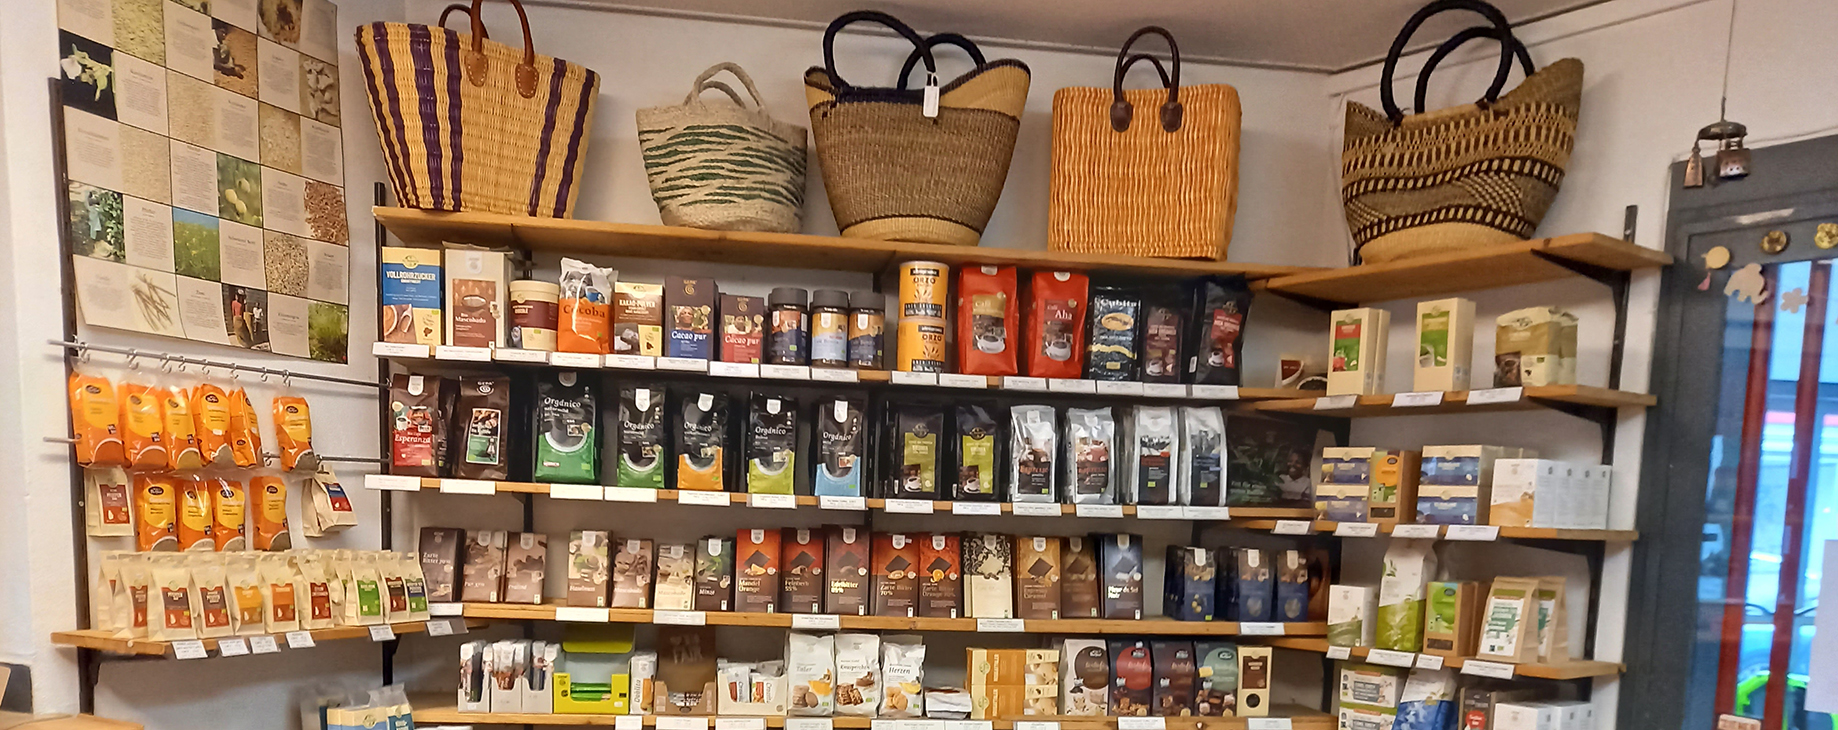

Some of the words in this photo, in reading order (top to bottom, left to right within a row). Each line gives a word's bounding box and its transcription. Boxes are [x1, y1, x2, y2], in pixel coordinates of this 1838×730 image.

[671, 330, 693, 340] Cacao
[694, 333, 707, 341] pur
[725, 335, 746, 344] Cacao
[747, 337, 759, 346] pur
[394, 434, 431, 444] Esperanza
